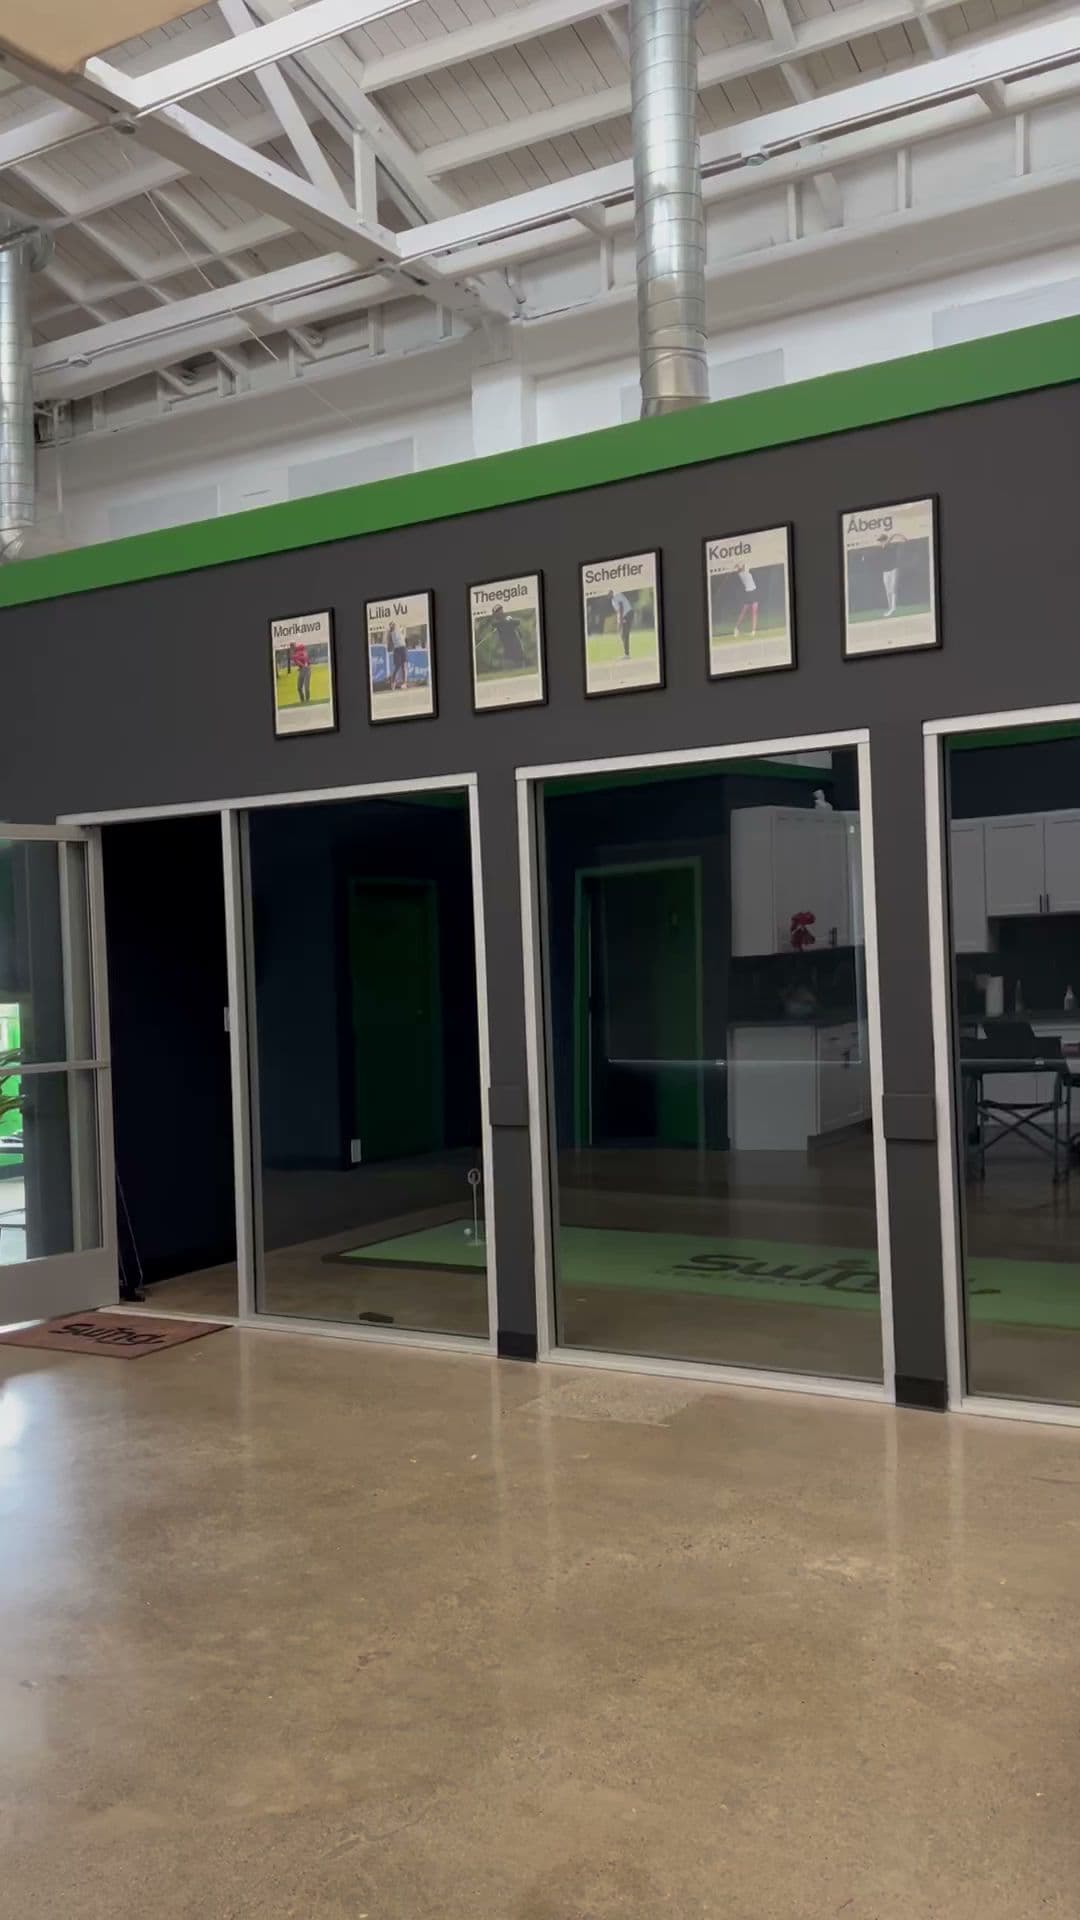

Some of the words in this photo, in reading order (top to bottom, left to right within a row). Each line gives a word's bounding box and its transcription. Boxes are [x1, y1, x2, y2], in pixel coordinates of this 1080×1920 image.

[847, 513, 893, 533] Åberg
[709, 541, 752, 560] Korda
[585, 564, 643, 583] Scheffler
[473, 584, 528, 603] Theegala
[369, 606, 391, 619] Lilia
[393, 603, 408, 615] Vu
[273, 621, 321, 637] Morikawa
